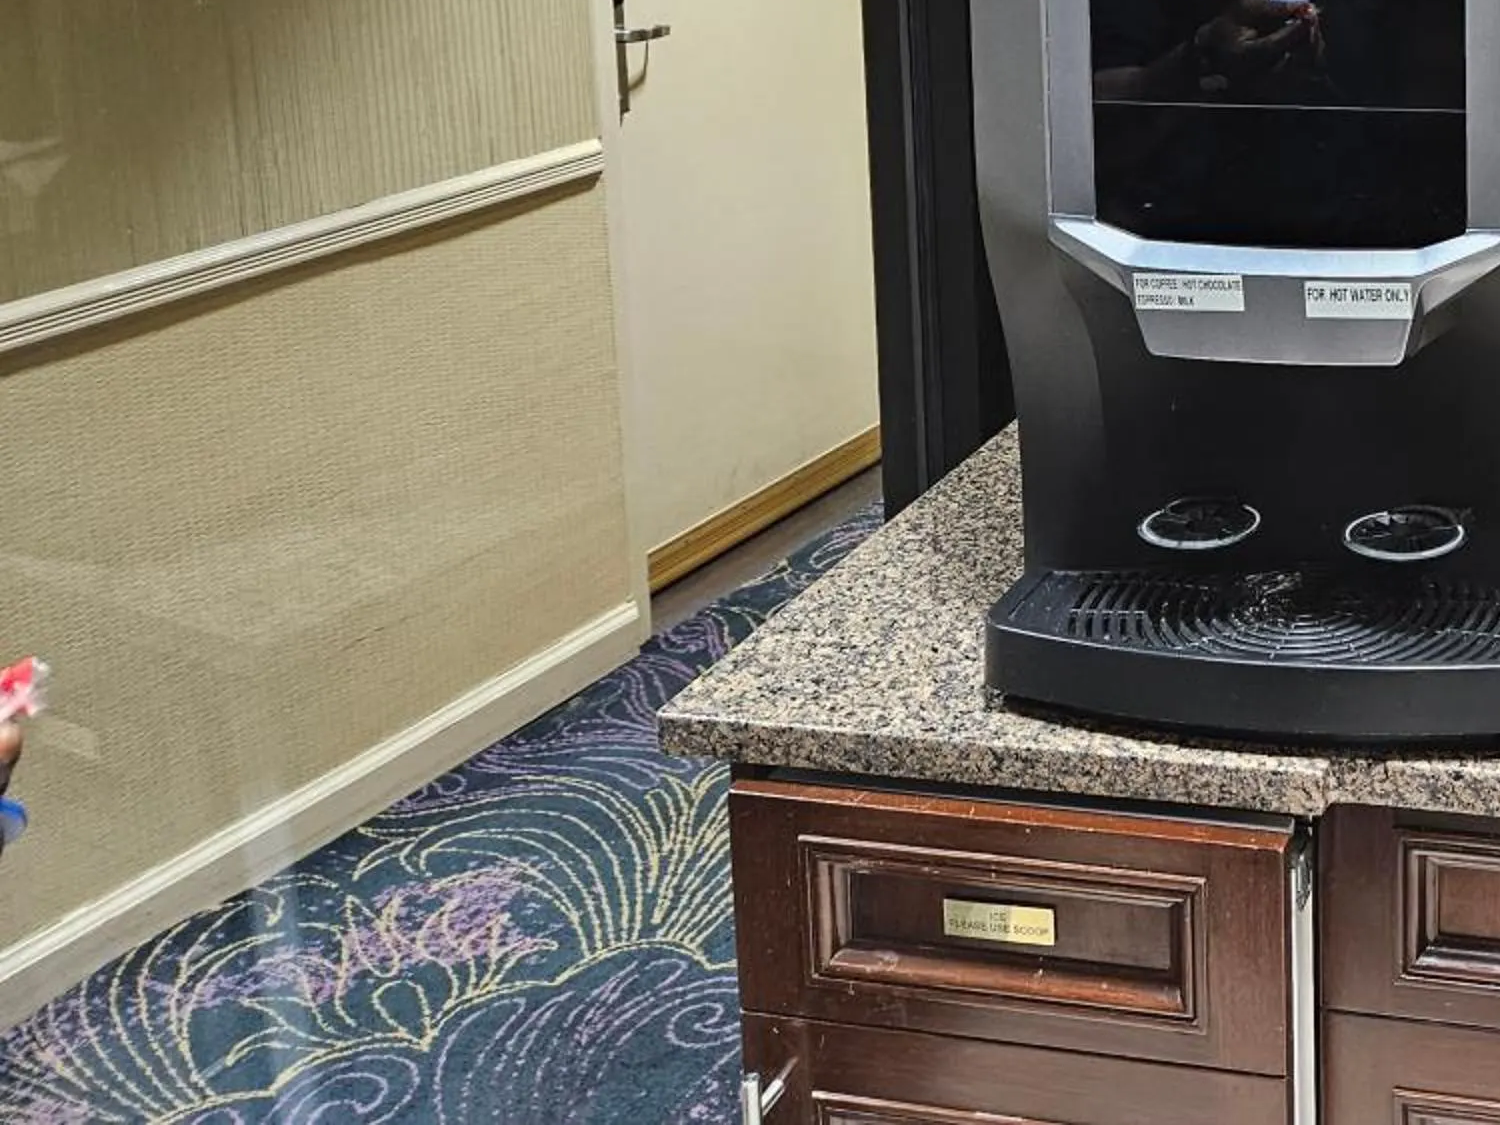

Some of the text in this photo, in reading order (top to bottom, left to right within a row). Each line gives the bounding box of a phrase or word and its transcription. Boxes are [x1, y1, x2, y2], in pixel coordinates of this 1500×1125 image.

[1307, 287, 1410, 302] FOR HOT WATER ONLY
[1013, 925, 1050, 937] SCOOP
